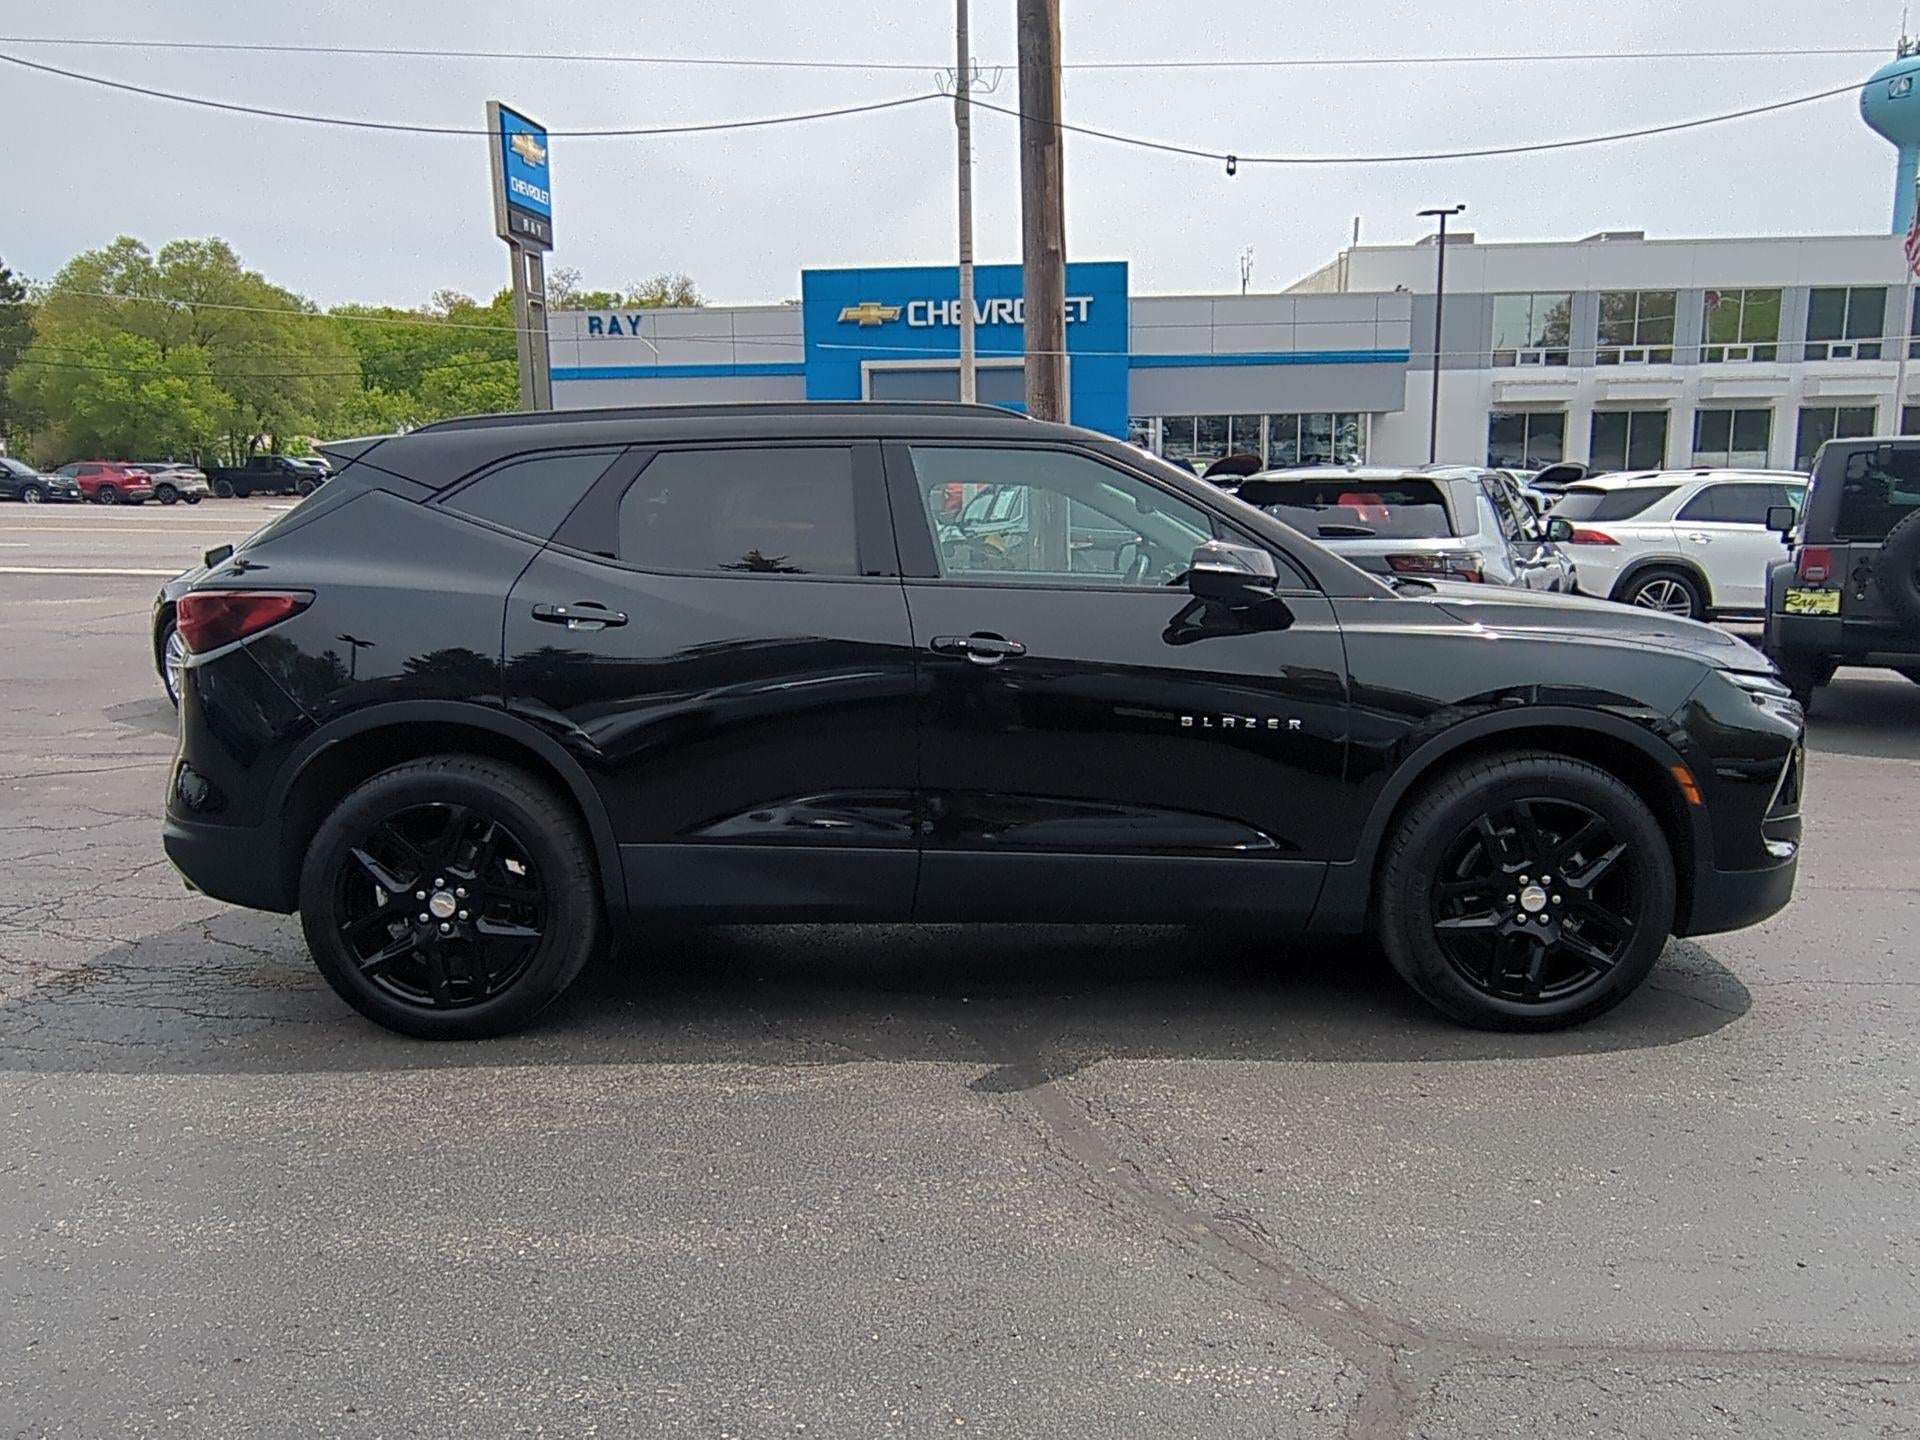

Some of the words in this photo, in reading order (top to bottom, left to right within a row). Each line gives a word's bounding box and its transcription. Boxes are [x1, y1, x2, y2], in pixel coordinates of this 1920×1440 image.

[511, 176, 549, 205] CHEVROLET
[523, 219, 542, 237] RAY
[907, 297, 1093, 326] CHEVROET
[588, 314, 641, 336] RAY
[1784, 593, 1817, 611] Ray
[1181, 716, 1301, 730] BLAZER
